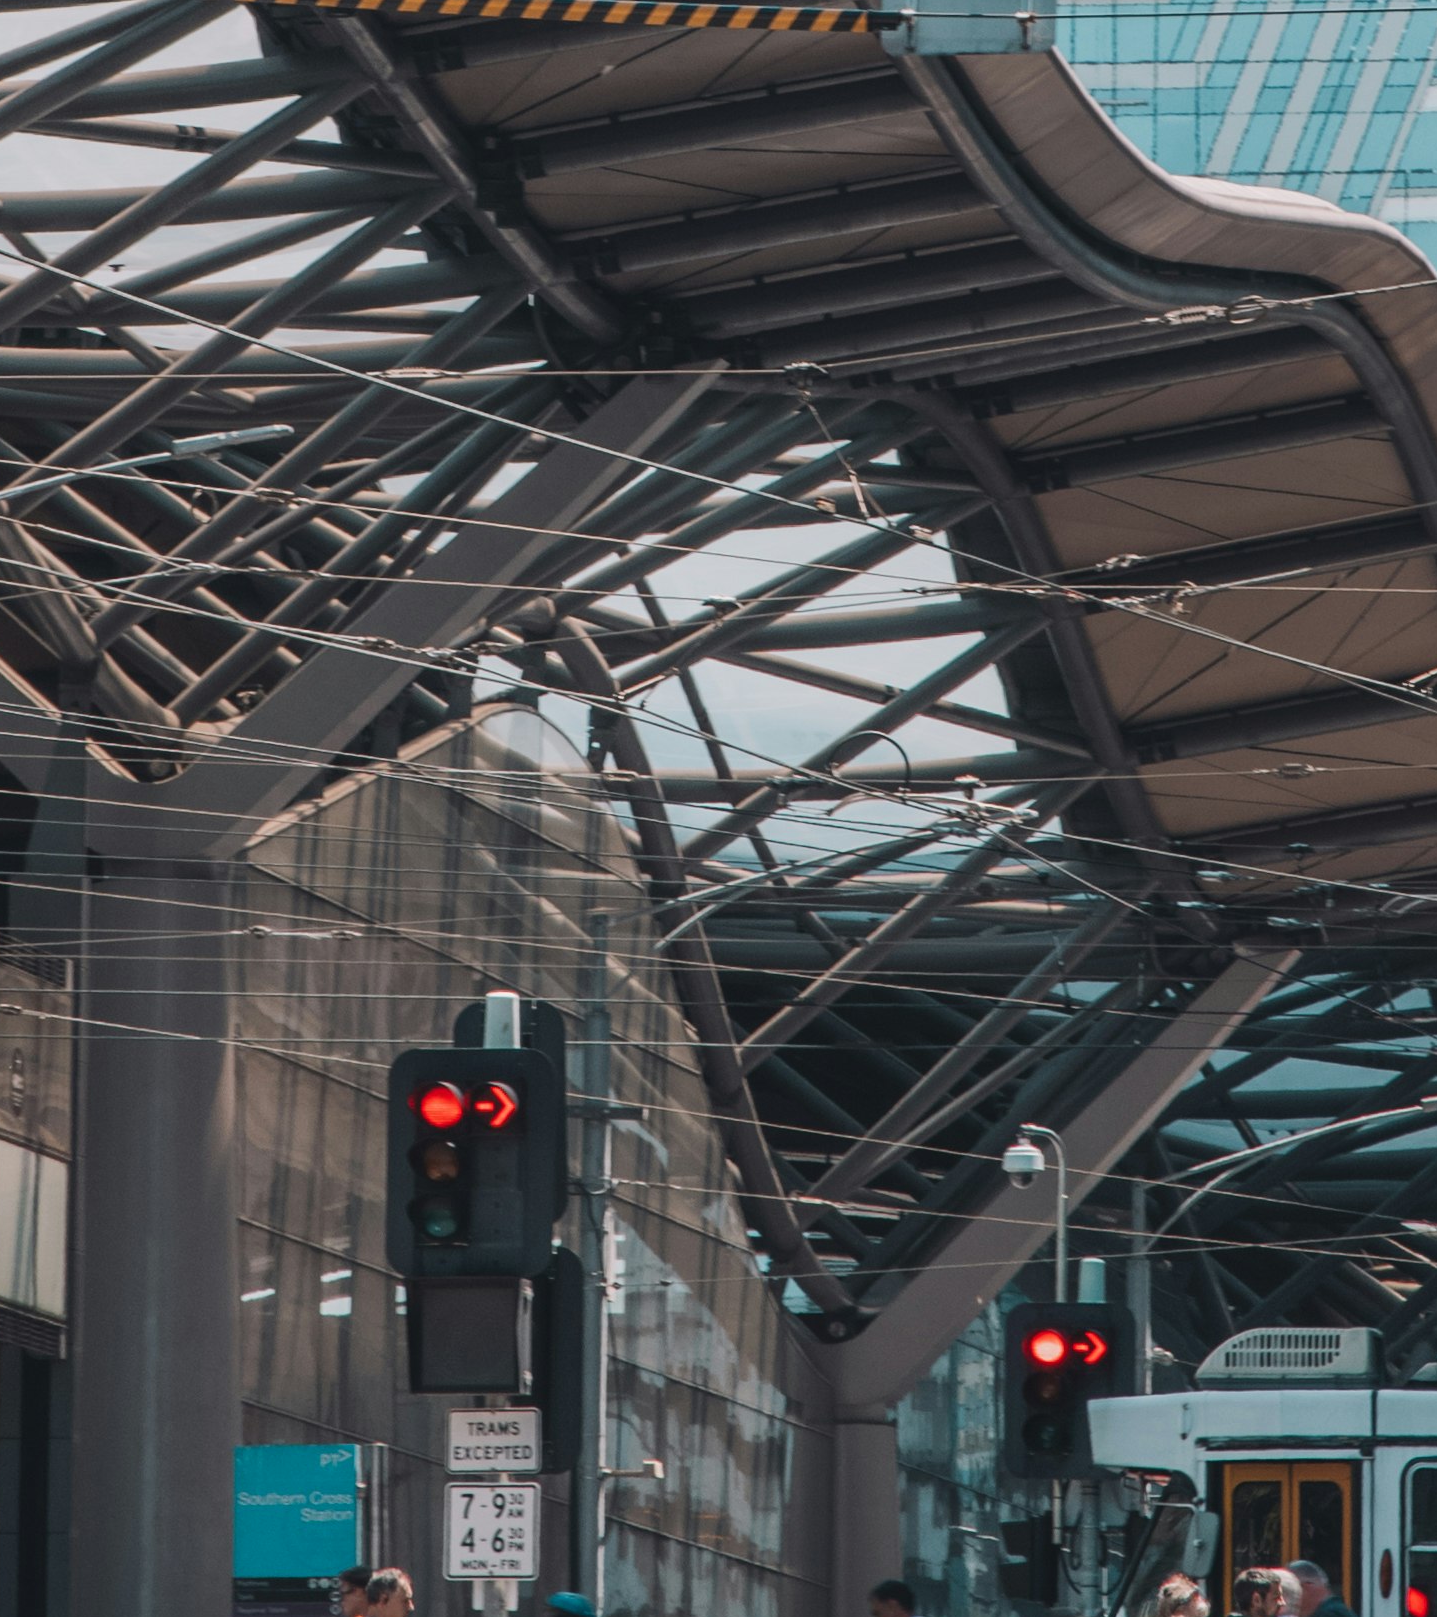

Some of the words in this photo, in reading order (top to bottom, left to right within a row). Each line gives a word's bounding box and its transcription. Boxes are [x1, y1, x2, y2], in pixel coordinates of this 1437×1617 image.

[467, 1422, 520, 1436] TRAMS
[453, 1445, 532, 1460] EXCEPTED
[237, 1491, 307, 1506] Southern
[310, 1491, 354, 1506] Cross
[300, 1508, 354, 1522] Station
